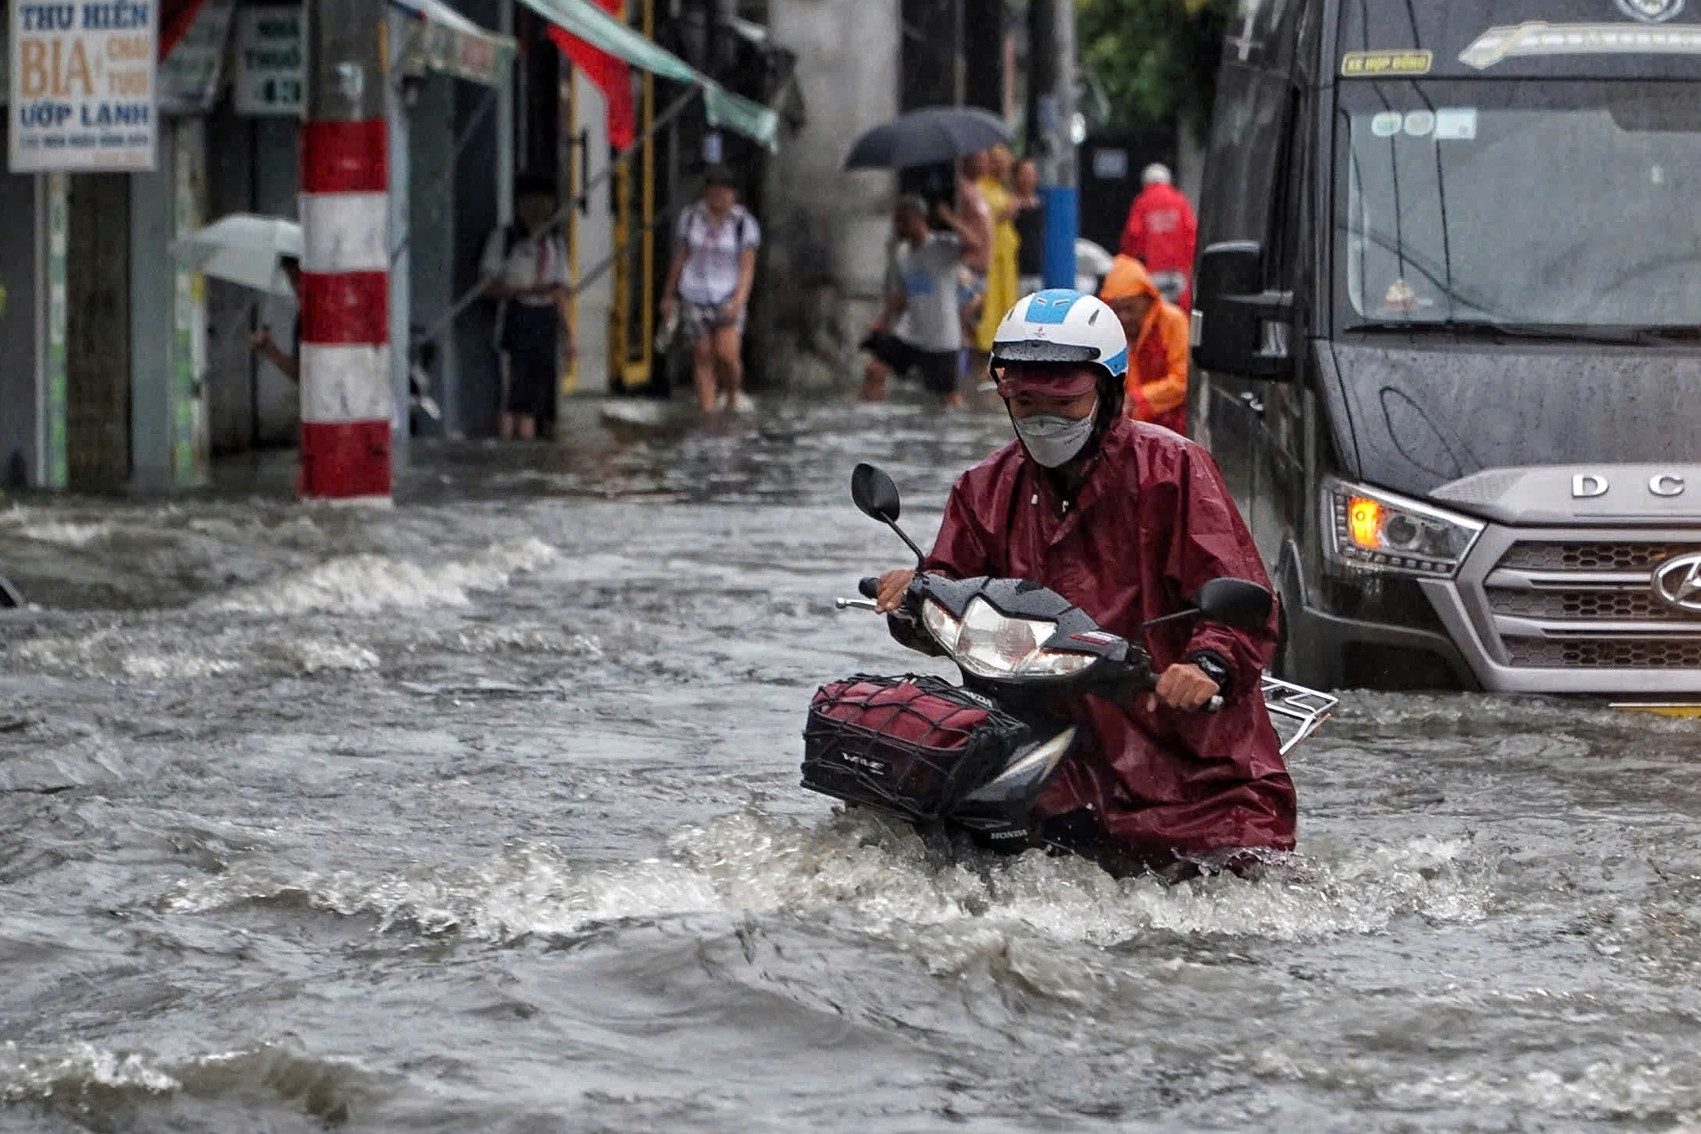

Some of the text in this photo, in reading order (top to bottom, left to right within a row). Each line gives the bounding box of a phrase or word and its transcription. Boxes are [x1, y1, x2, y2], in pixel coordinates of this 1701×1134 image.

[20, 4, 74, 30] THU
[21, 38, 94, 98] BIA
[990, 829, 1028, 840] HONDA
